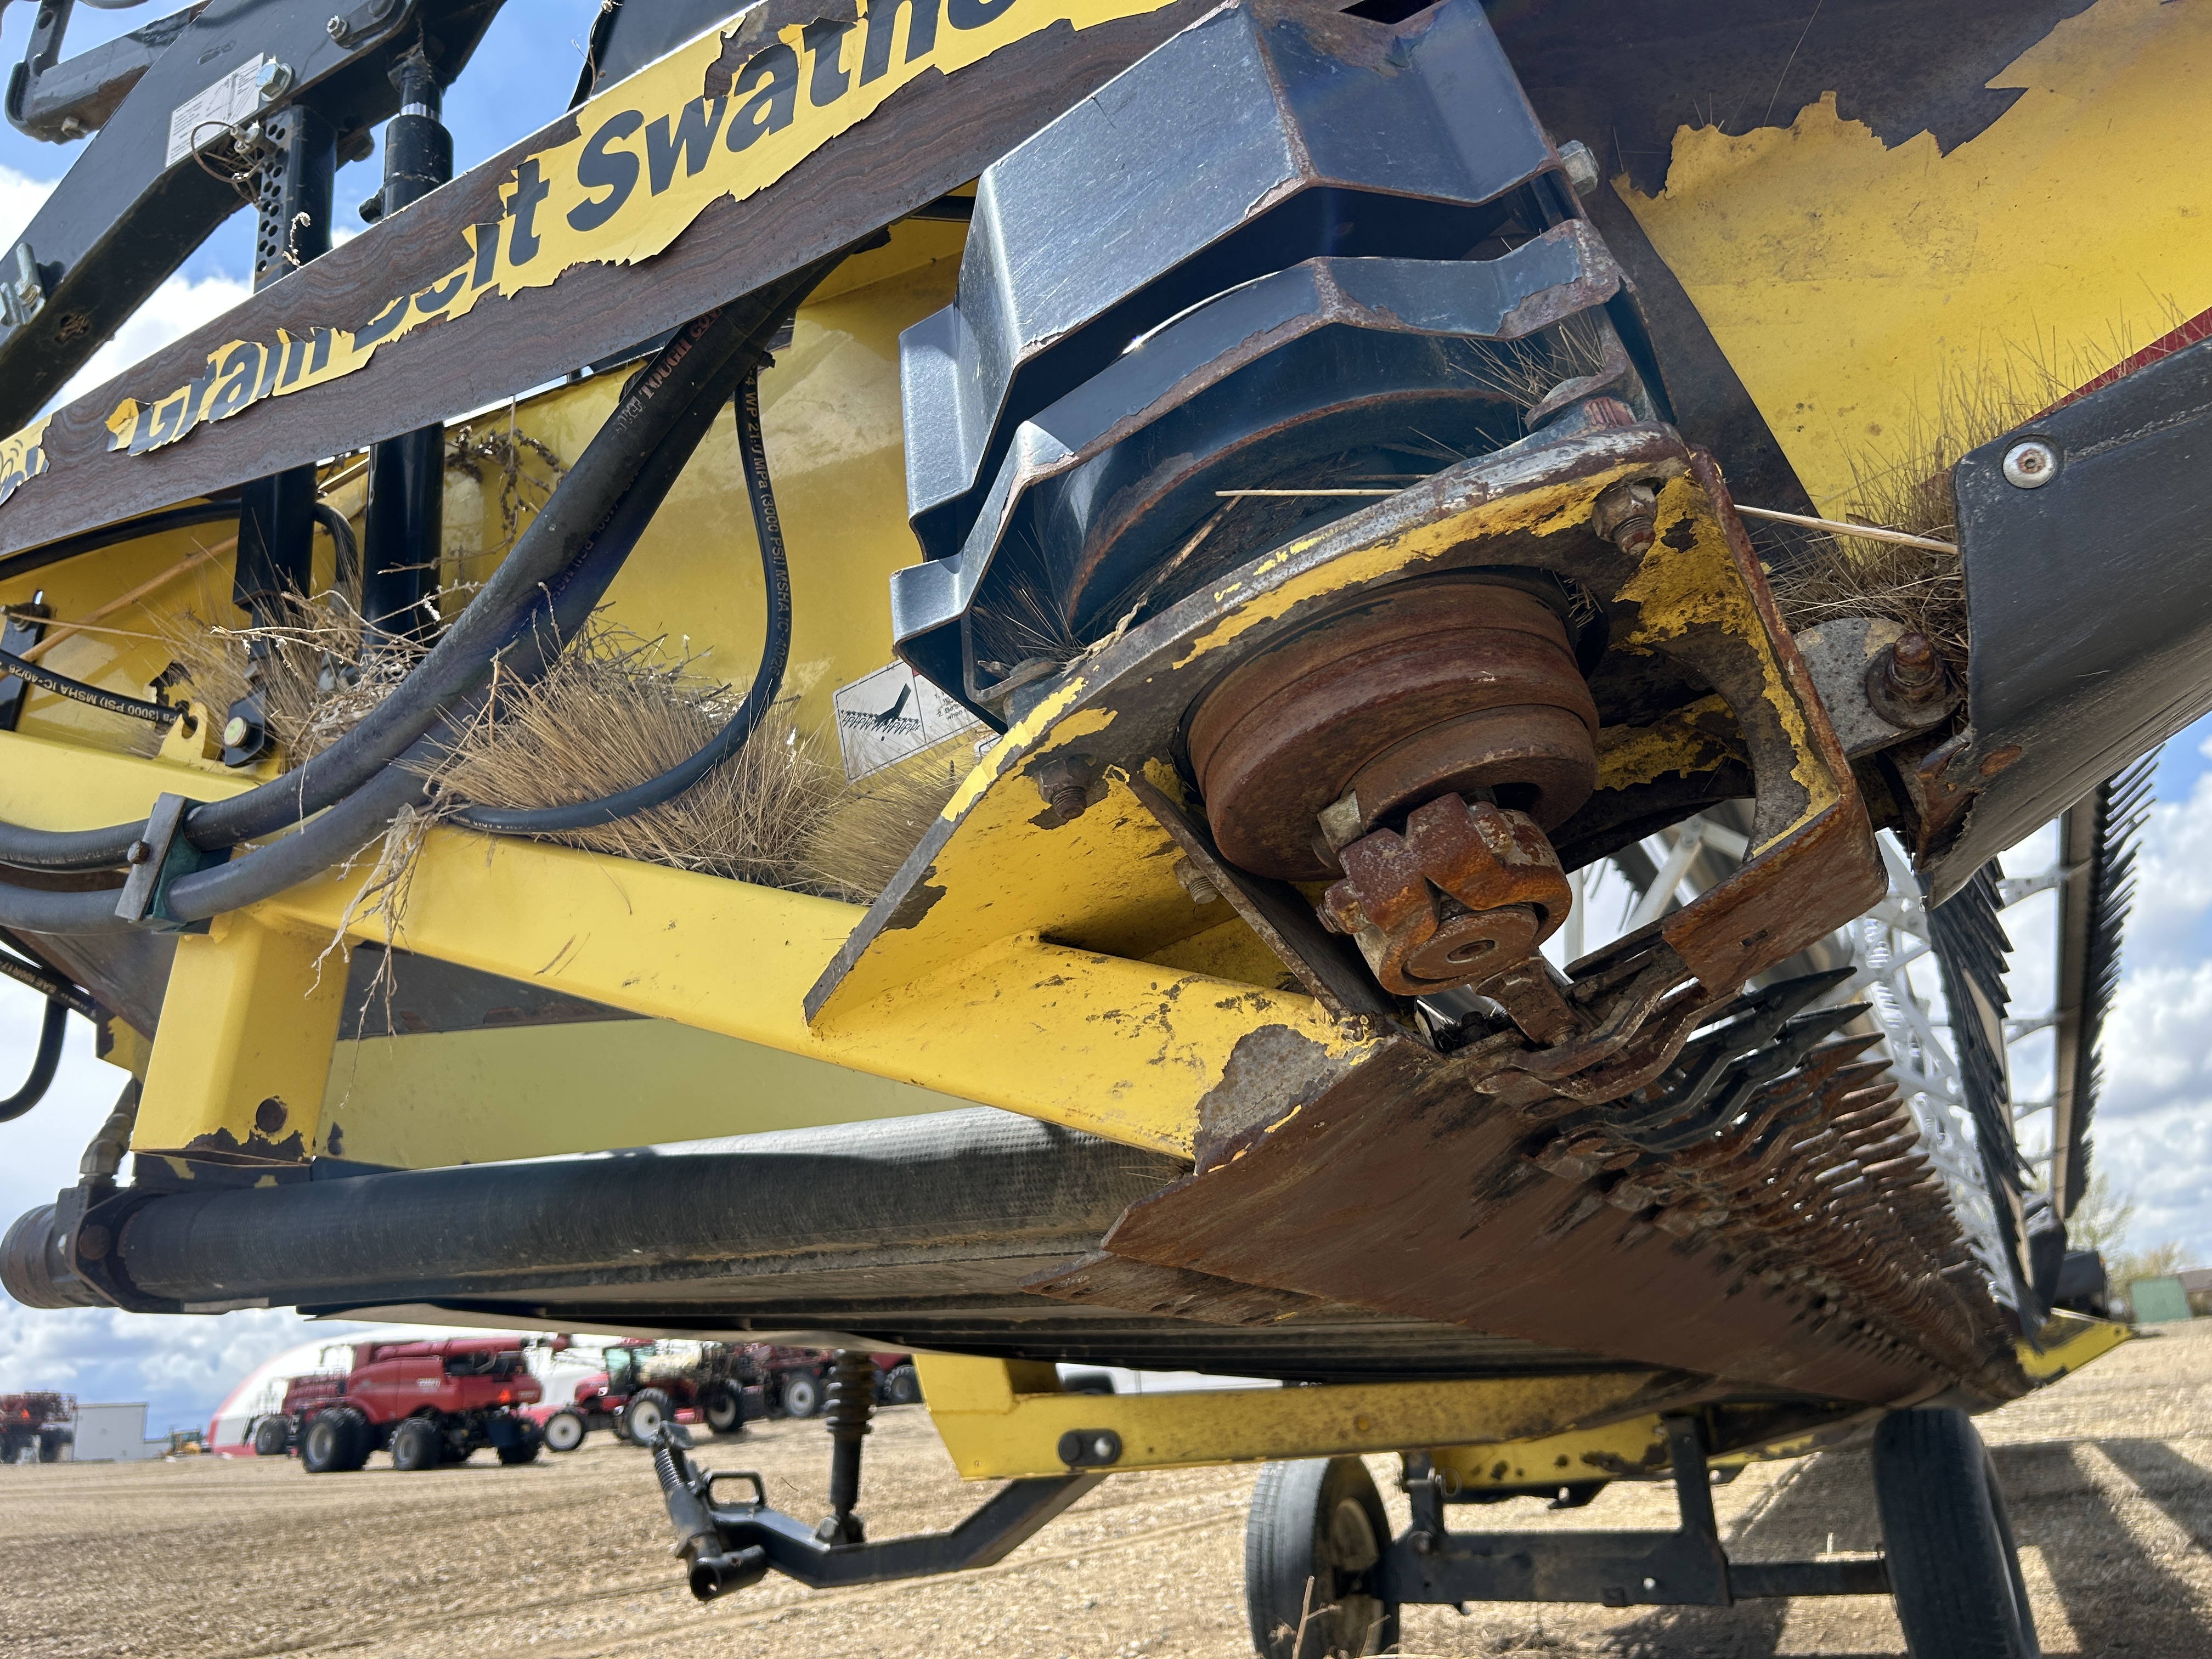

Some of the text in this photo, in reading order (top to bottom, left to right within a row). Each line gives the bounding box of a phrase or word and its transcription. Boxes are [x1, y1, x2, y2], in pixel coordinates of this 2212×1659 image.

[639, 337, 693, 399] TOUGH
[745, 391, 758, 417] WP
[753, 457, 768, 489] MPa
[760, 493, 780, 533] (3000
[770, 536, 786, 566] PSI)
[775, 568, 790, 613] MSHA
[8, 663, 58, 691] IC-40/26
[60, 684, 98, 705] MSHA
[99, 696, 125, 713] PSI)
[127, 704, 159, 721] (3000
[946, 709, 963, 721] when
